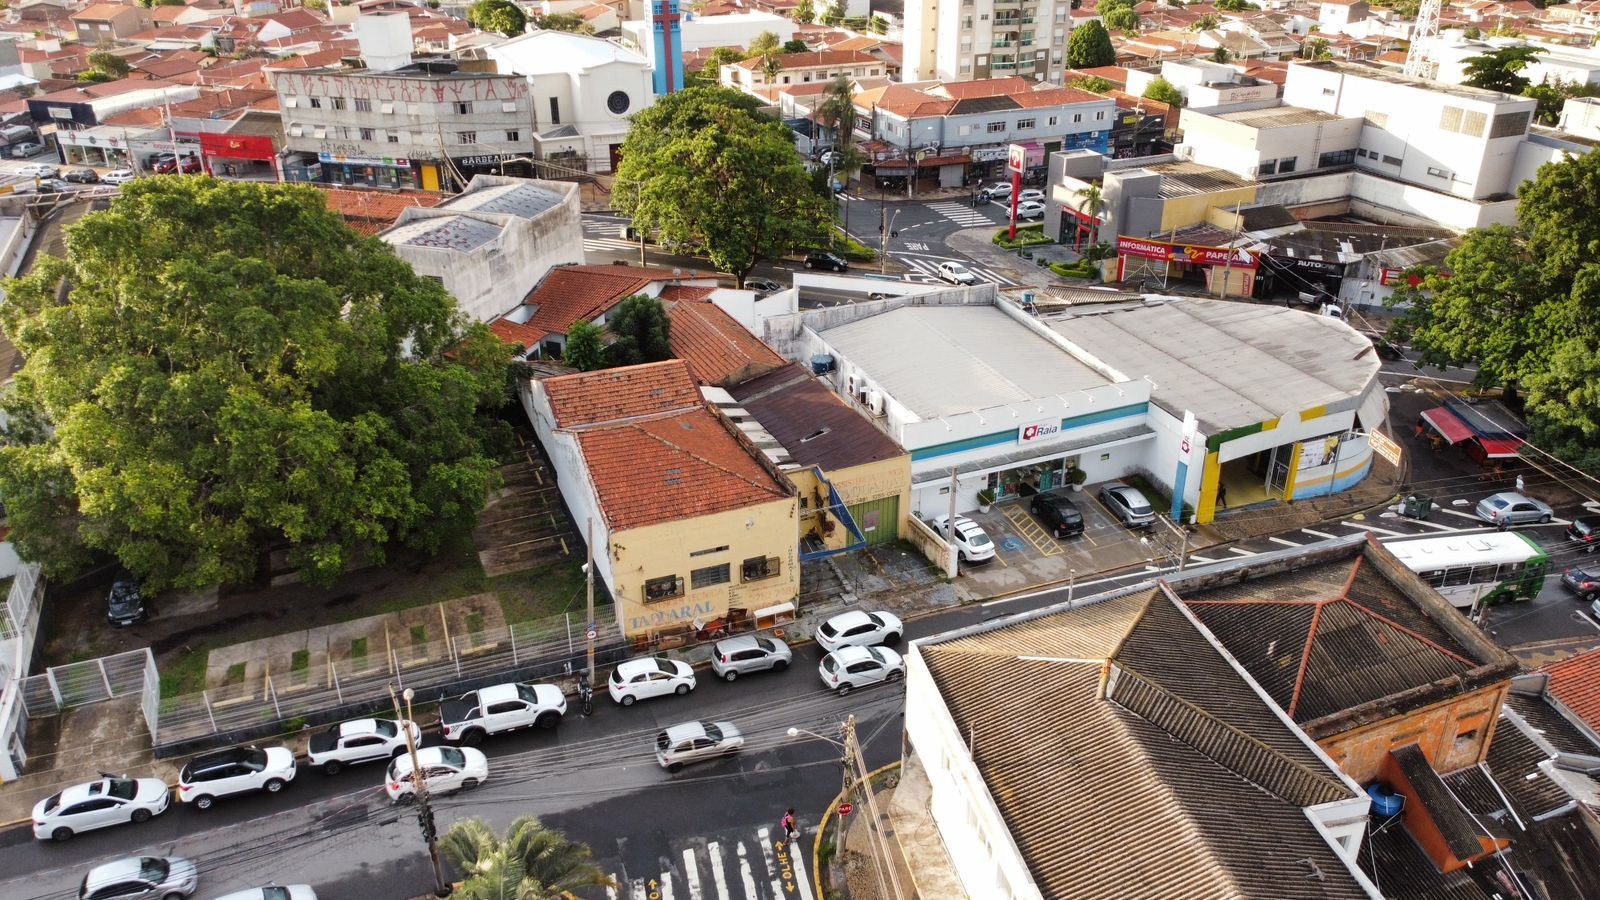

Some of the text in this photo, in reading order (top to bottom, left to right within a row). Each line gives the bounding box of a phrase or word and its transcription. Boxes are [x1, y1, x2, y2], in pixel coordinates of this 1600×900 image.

[1119, 240, 1166, 254] INFORMÁTICA
[1037, 425, 1058, 436] Raia
[777, 851, 792, 879] OLHE
